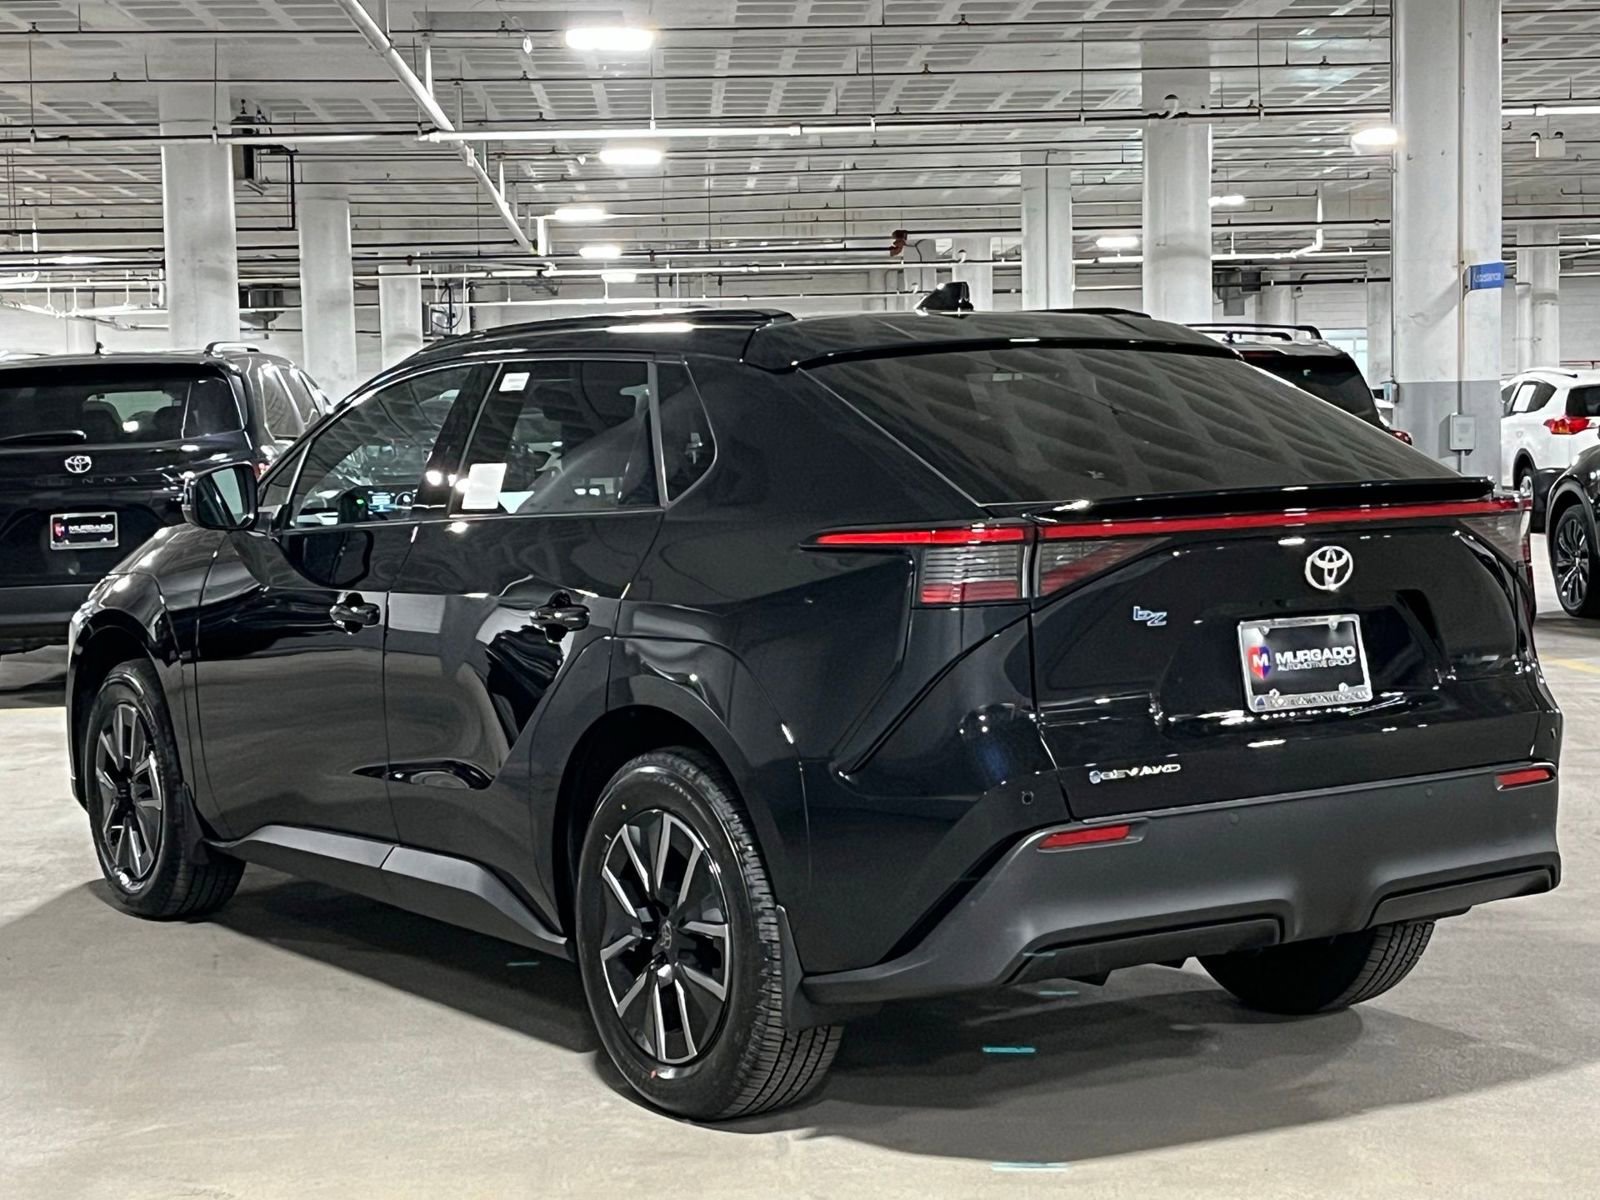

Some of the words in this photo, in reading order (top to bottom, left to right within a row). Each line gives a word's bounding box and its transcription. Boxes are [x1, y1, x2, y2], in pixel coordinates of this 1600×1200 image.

[1252, 653, 1269, 668] M
[1275, 646, 1356, 665] MURGADO
[1277, 661, 1328, 671] AUTOMOTIVE
[1328, 658, 1356, 667] GROUP
[1139, 764, 1181, 776] AWD
